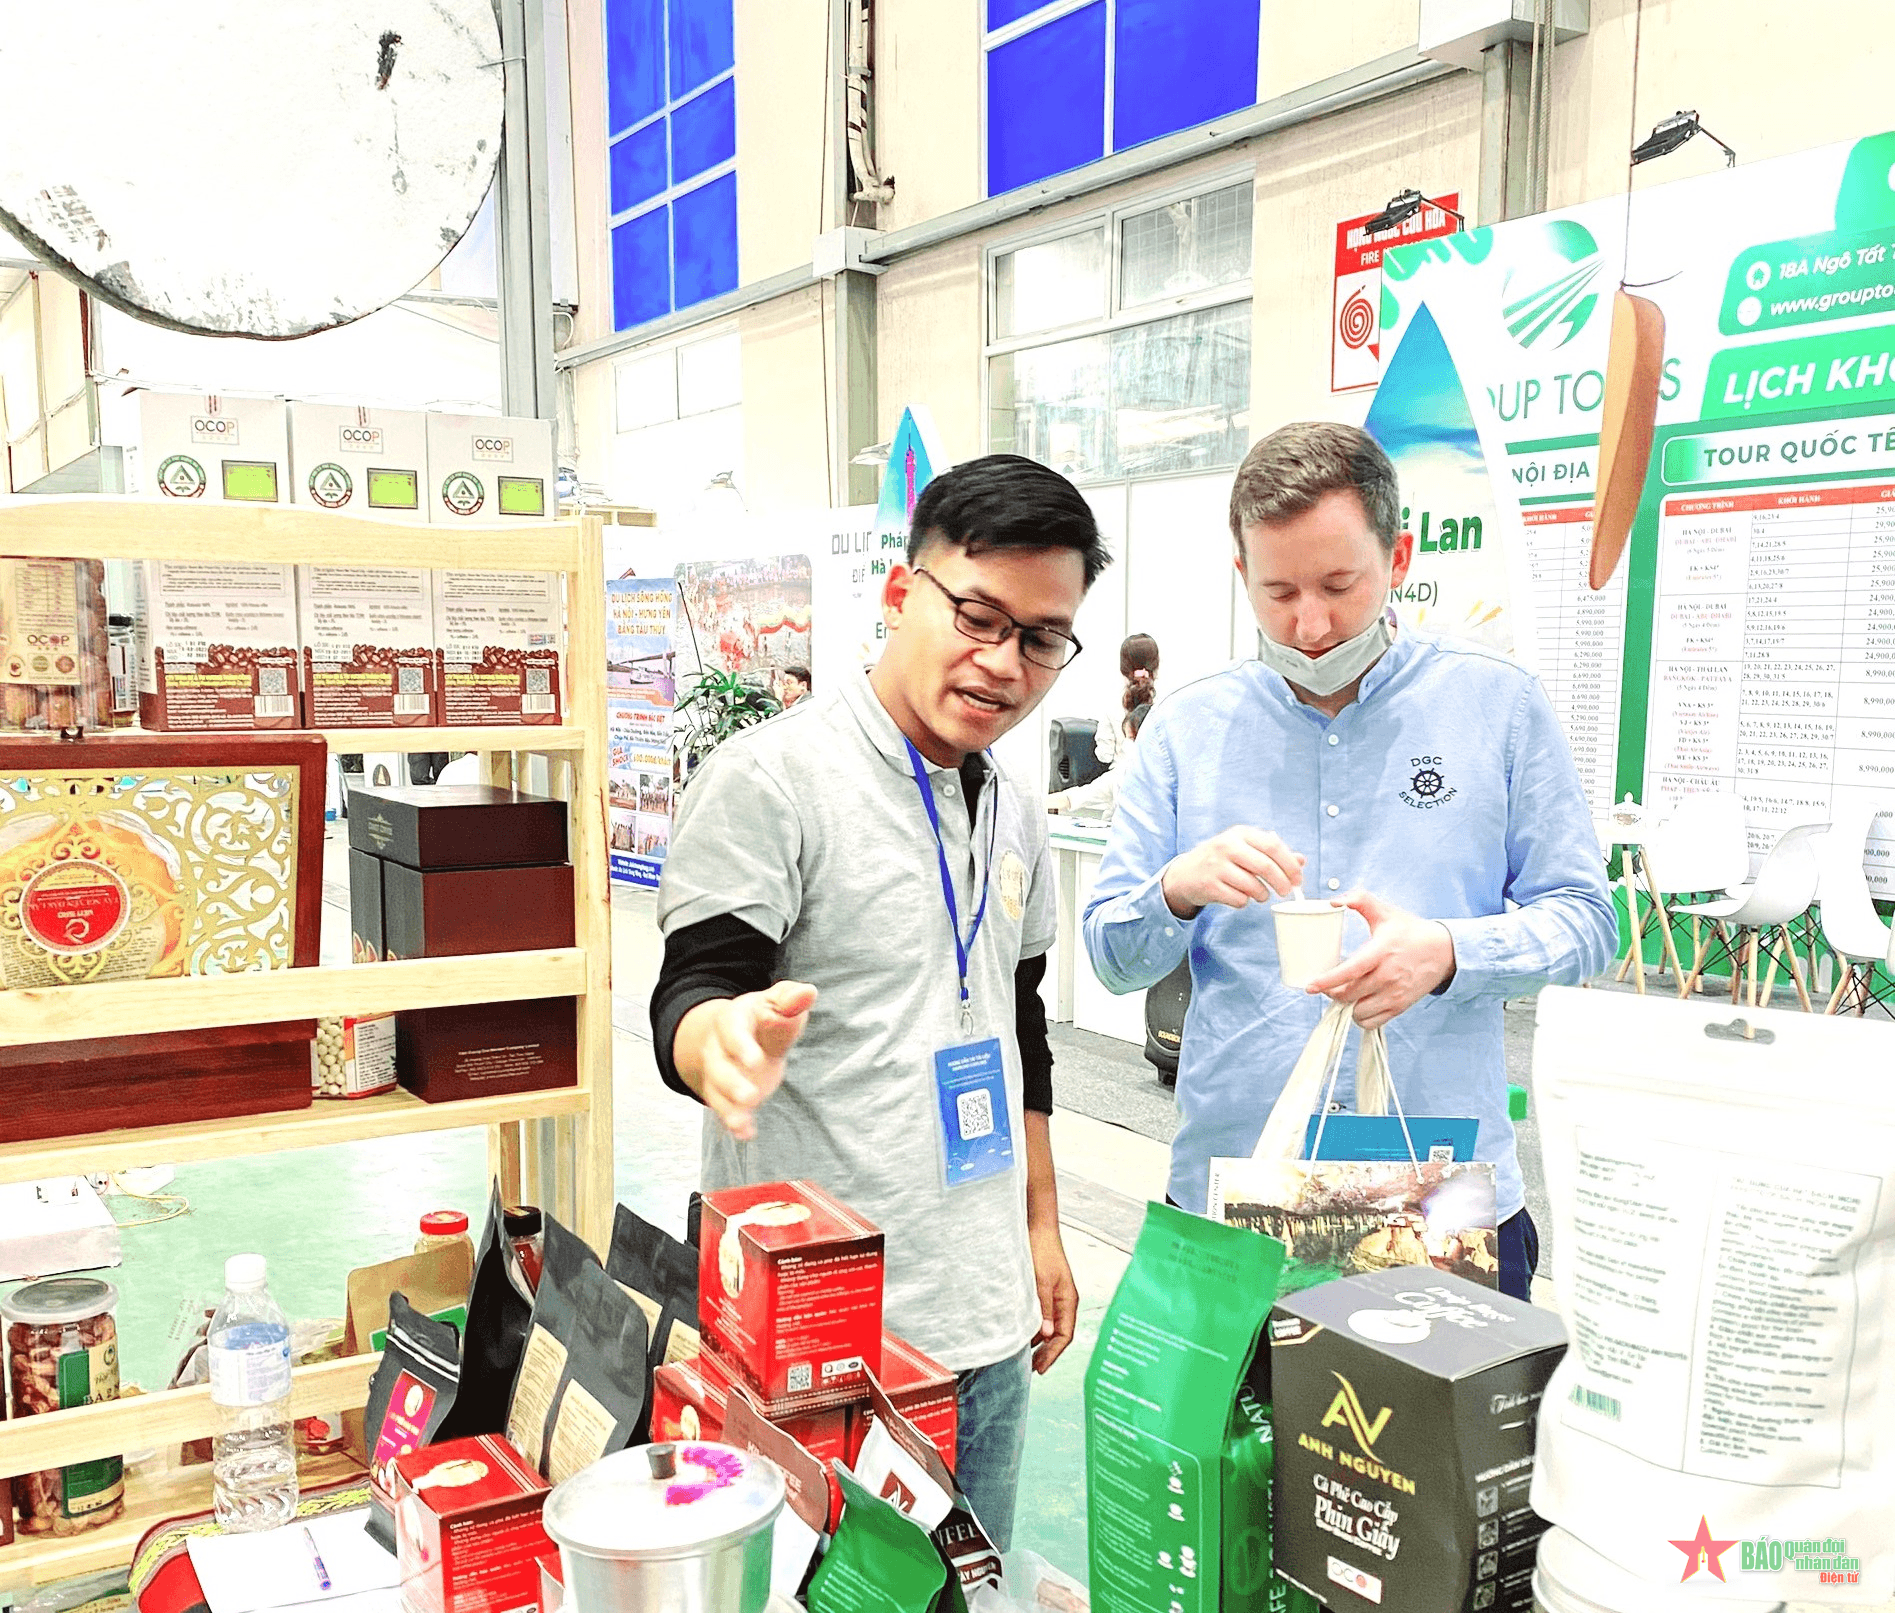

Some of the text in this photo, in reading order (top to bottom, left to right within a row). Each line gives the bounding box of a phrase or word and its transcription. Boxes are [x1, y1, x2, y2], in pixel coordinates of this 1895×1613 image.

[1361, 250, 1379, 266] FIRE
[1780, 259, 1808, 280] 18A
[1856, 244, 1887, 266] Tất
[1770, 284, 1895, 315] www.groupto
[1723, 362, 1816, 410] LỊCH
[194, 420, 235, 435] OCOP
[343, 428, 380, 443] OCOP
[475, 438, 510, 452] OCOP
[1704, 444, 1770, 467] TOUR
[1780, 430, 1858, 463] QUỐC
[1512, 461, 1590, 487] NỘI ĐỊA
[832, 534, 850, 555] DU
[1420, 512, 1483, 553] Lan
[871, 559, 886, 575] Hà
[1411, 756, 1442, 767] DGC
[1399, 787, 1457, 809] SELECTION
[1298, 1432, 1416, 1495] ANH NGUYEN
[1314, 1494, 1353, 1533] Phin
